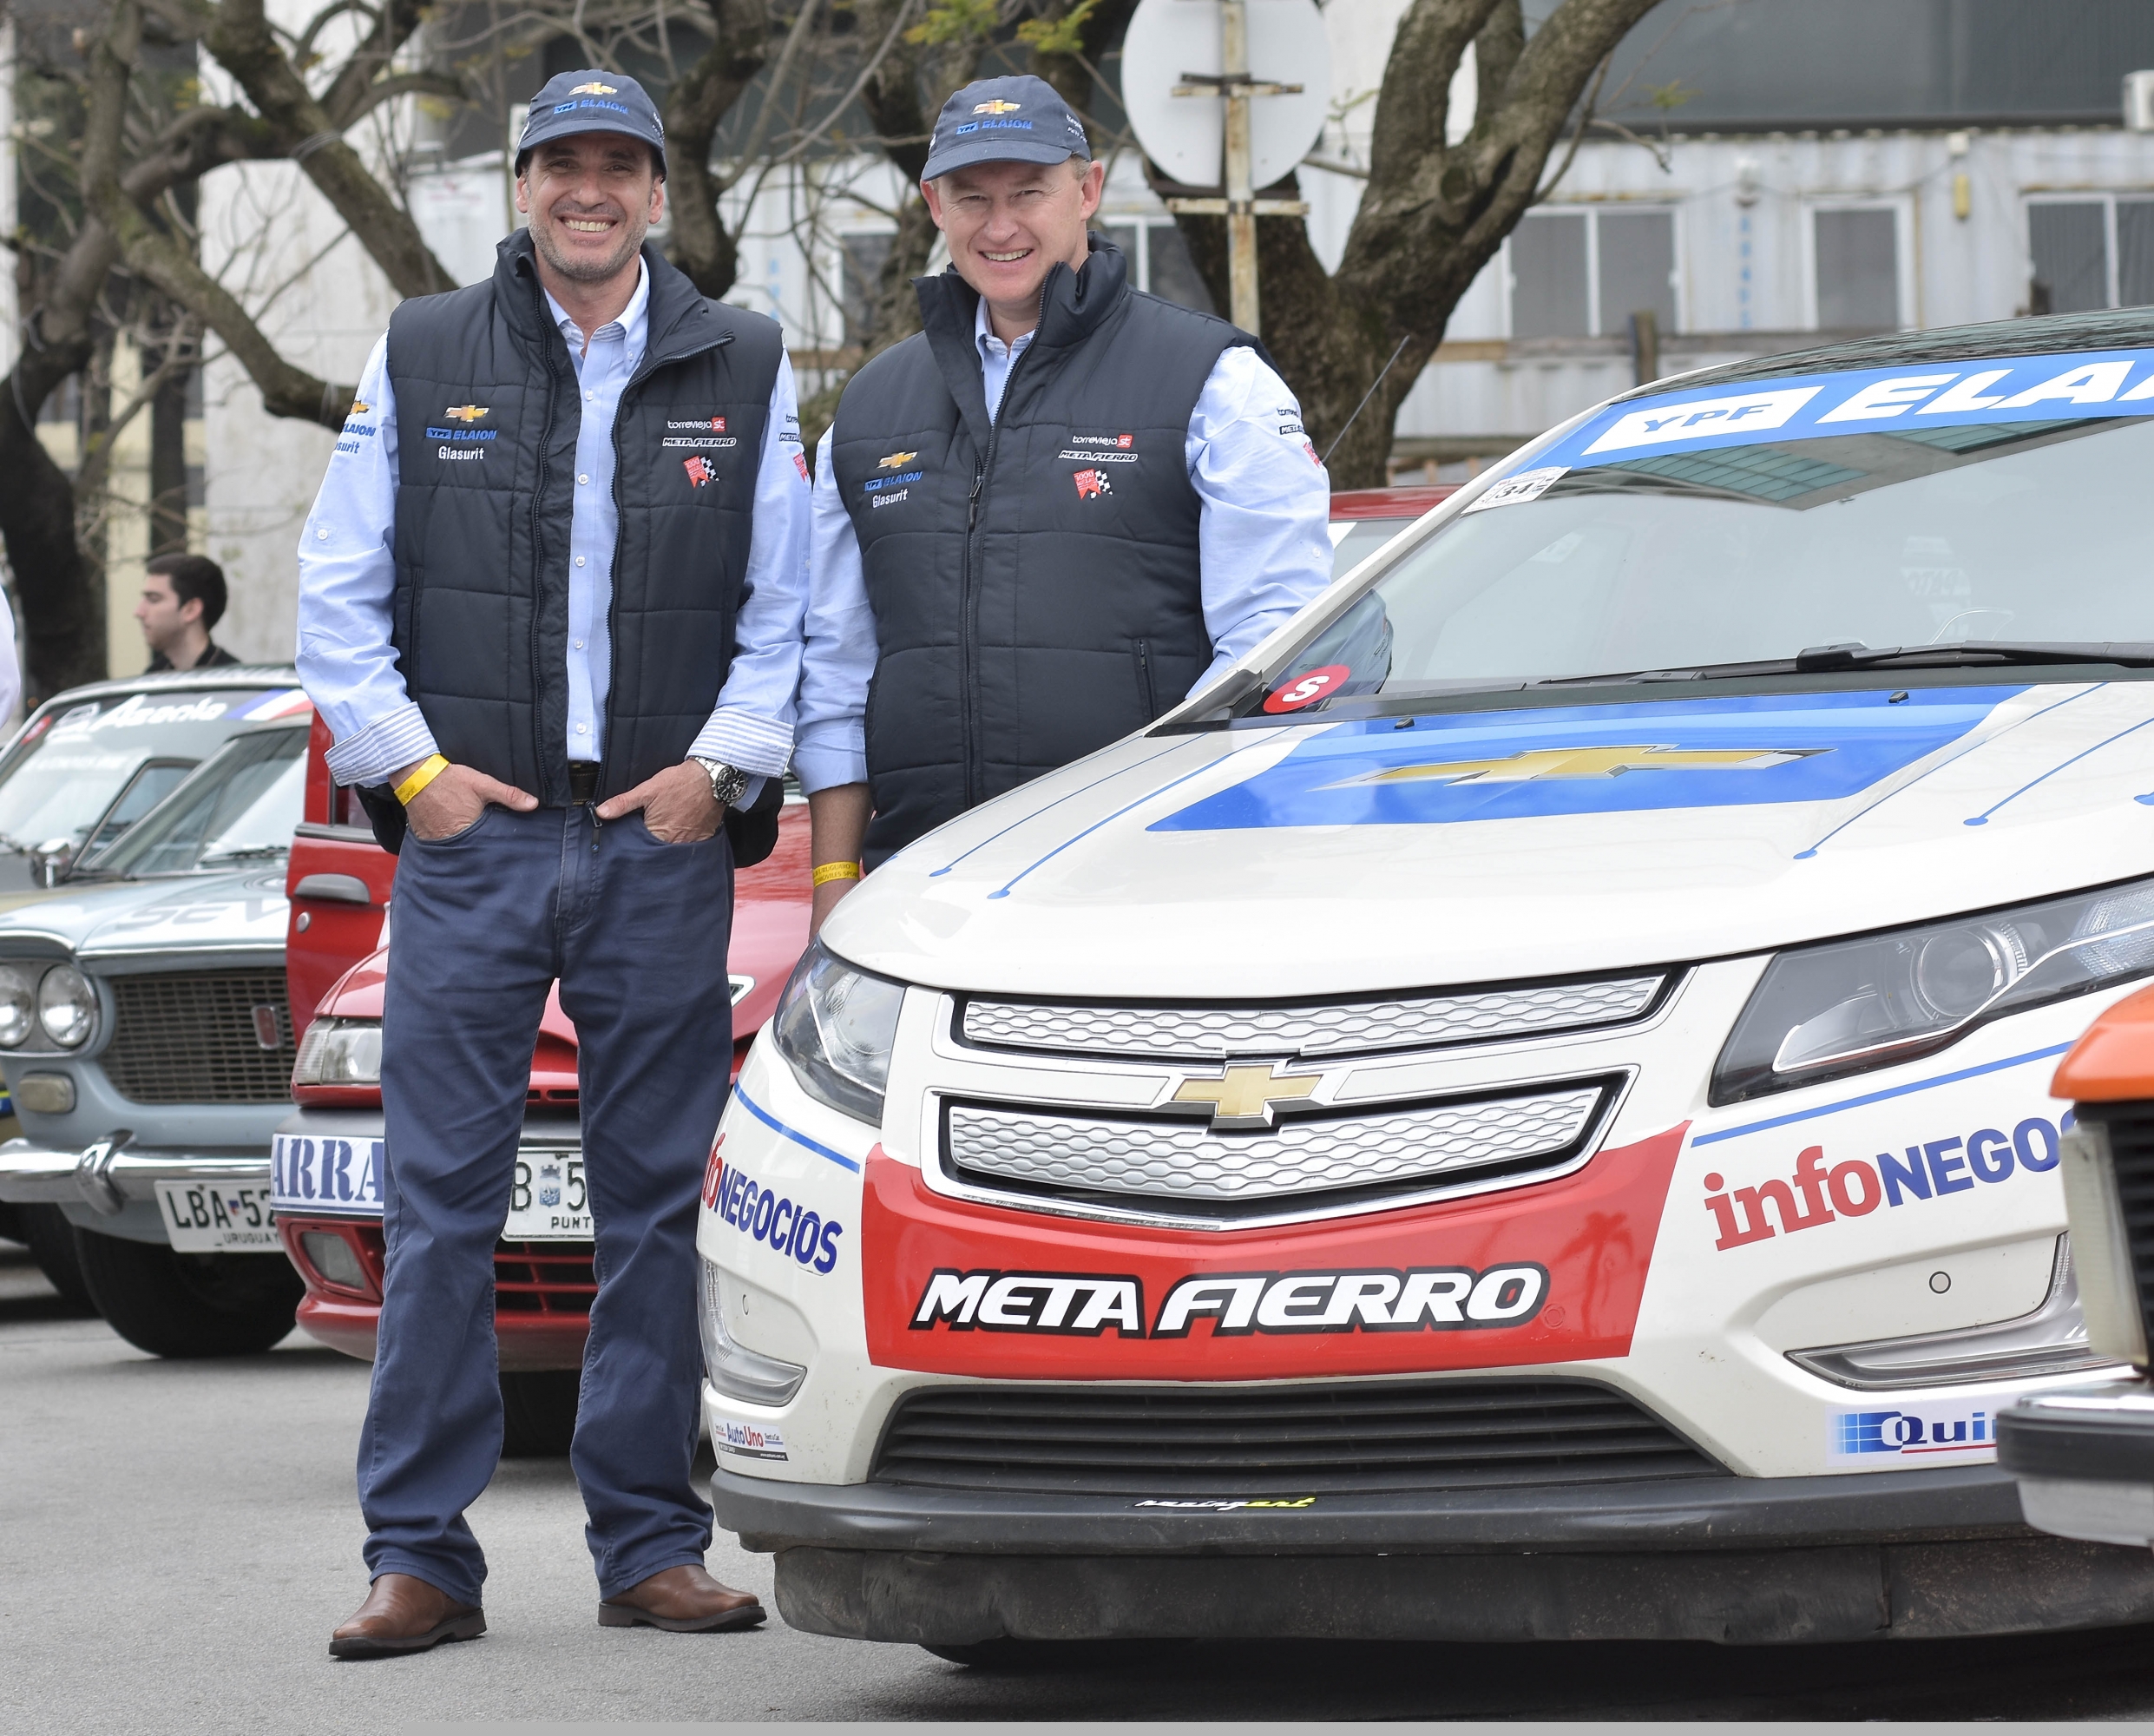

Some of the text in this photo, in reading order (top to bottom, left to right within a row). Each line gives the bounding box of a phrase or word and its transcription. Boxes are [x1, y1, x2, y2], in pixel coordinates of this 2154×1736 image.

[580, 99, 629, 115] ELAION
[982, 119, 1033, 129] ELAION
[667, 420, 712, 430] torrevieja
[1643, 402, 1774, 433] YPF
[453, 430, 497, 440] ELAION
[662, 437, 737, 447] META FIERRO
[1072, 435, 1118, 446] torrevieja
[337, 441, 360, 454] surit
[438, 445, 484, 460] Glasurit
[1059, 450, 1138, 462] META FIERRO
[883, 471, 923, 487] ELAION
[1495, 482, 1534, 499] 34
[872, 489, 909, 509] Glasurit
[1282, 675, 1330, 702] S
[510, 1161, 587, 1212] B 5
[166, 1190, 232, 1229] LBA
[702, 1132, 844, 1274] foNEGOCIOS
[551, 1216, 591, 1229] PUNT
[223, 1233, 279, 1245] URUGUAY
[914, 1266, 1545, 1332] META FIERRO
[1881, 1411, 1996, 1447] Qui
